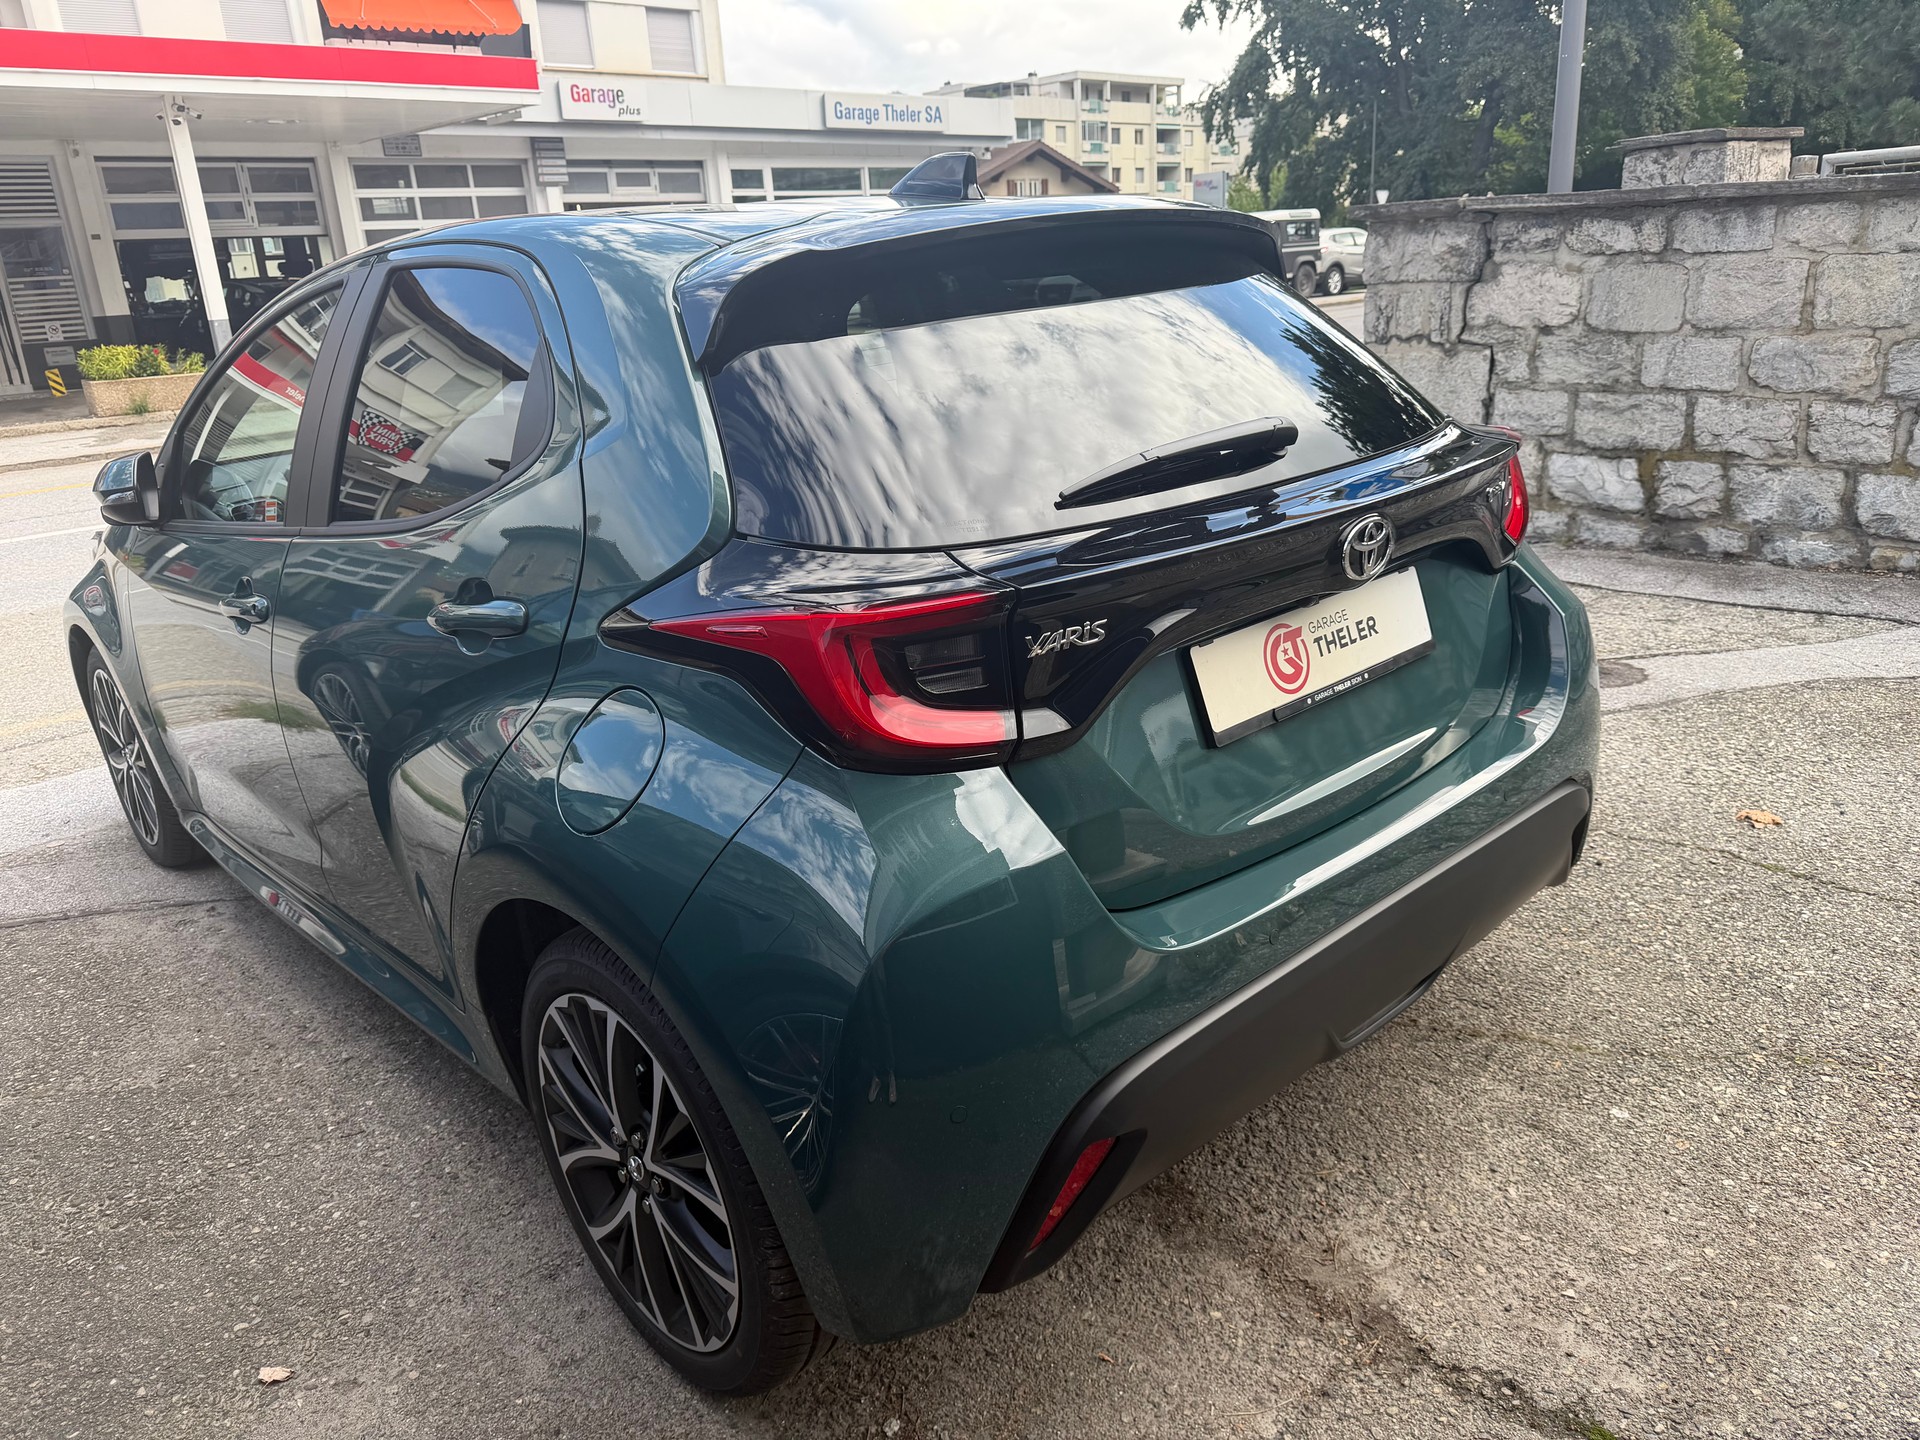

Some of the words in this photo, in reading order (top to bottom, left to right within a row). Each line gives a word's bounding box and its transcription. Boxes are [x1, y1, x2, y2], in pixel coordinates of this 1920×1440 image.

[570, 84, 625, 108] Garage
[618, 105, 641, 117] plus
[834, 101, 880, 125] Garage
[882, 103, 921, 122] Theler
[925, 105, 943, 123] SA
[1308, 609, 1349, 634] GARAGE
[1312, 615, 1379, 657] THELER
[1314, 688, 1333, 701] GARAGE
[1333, 680, 1351, 692] THELER
